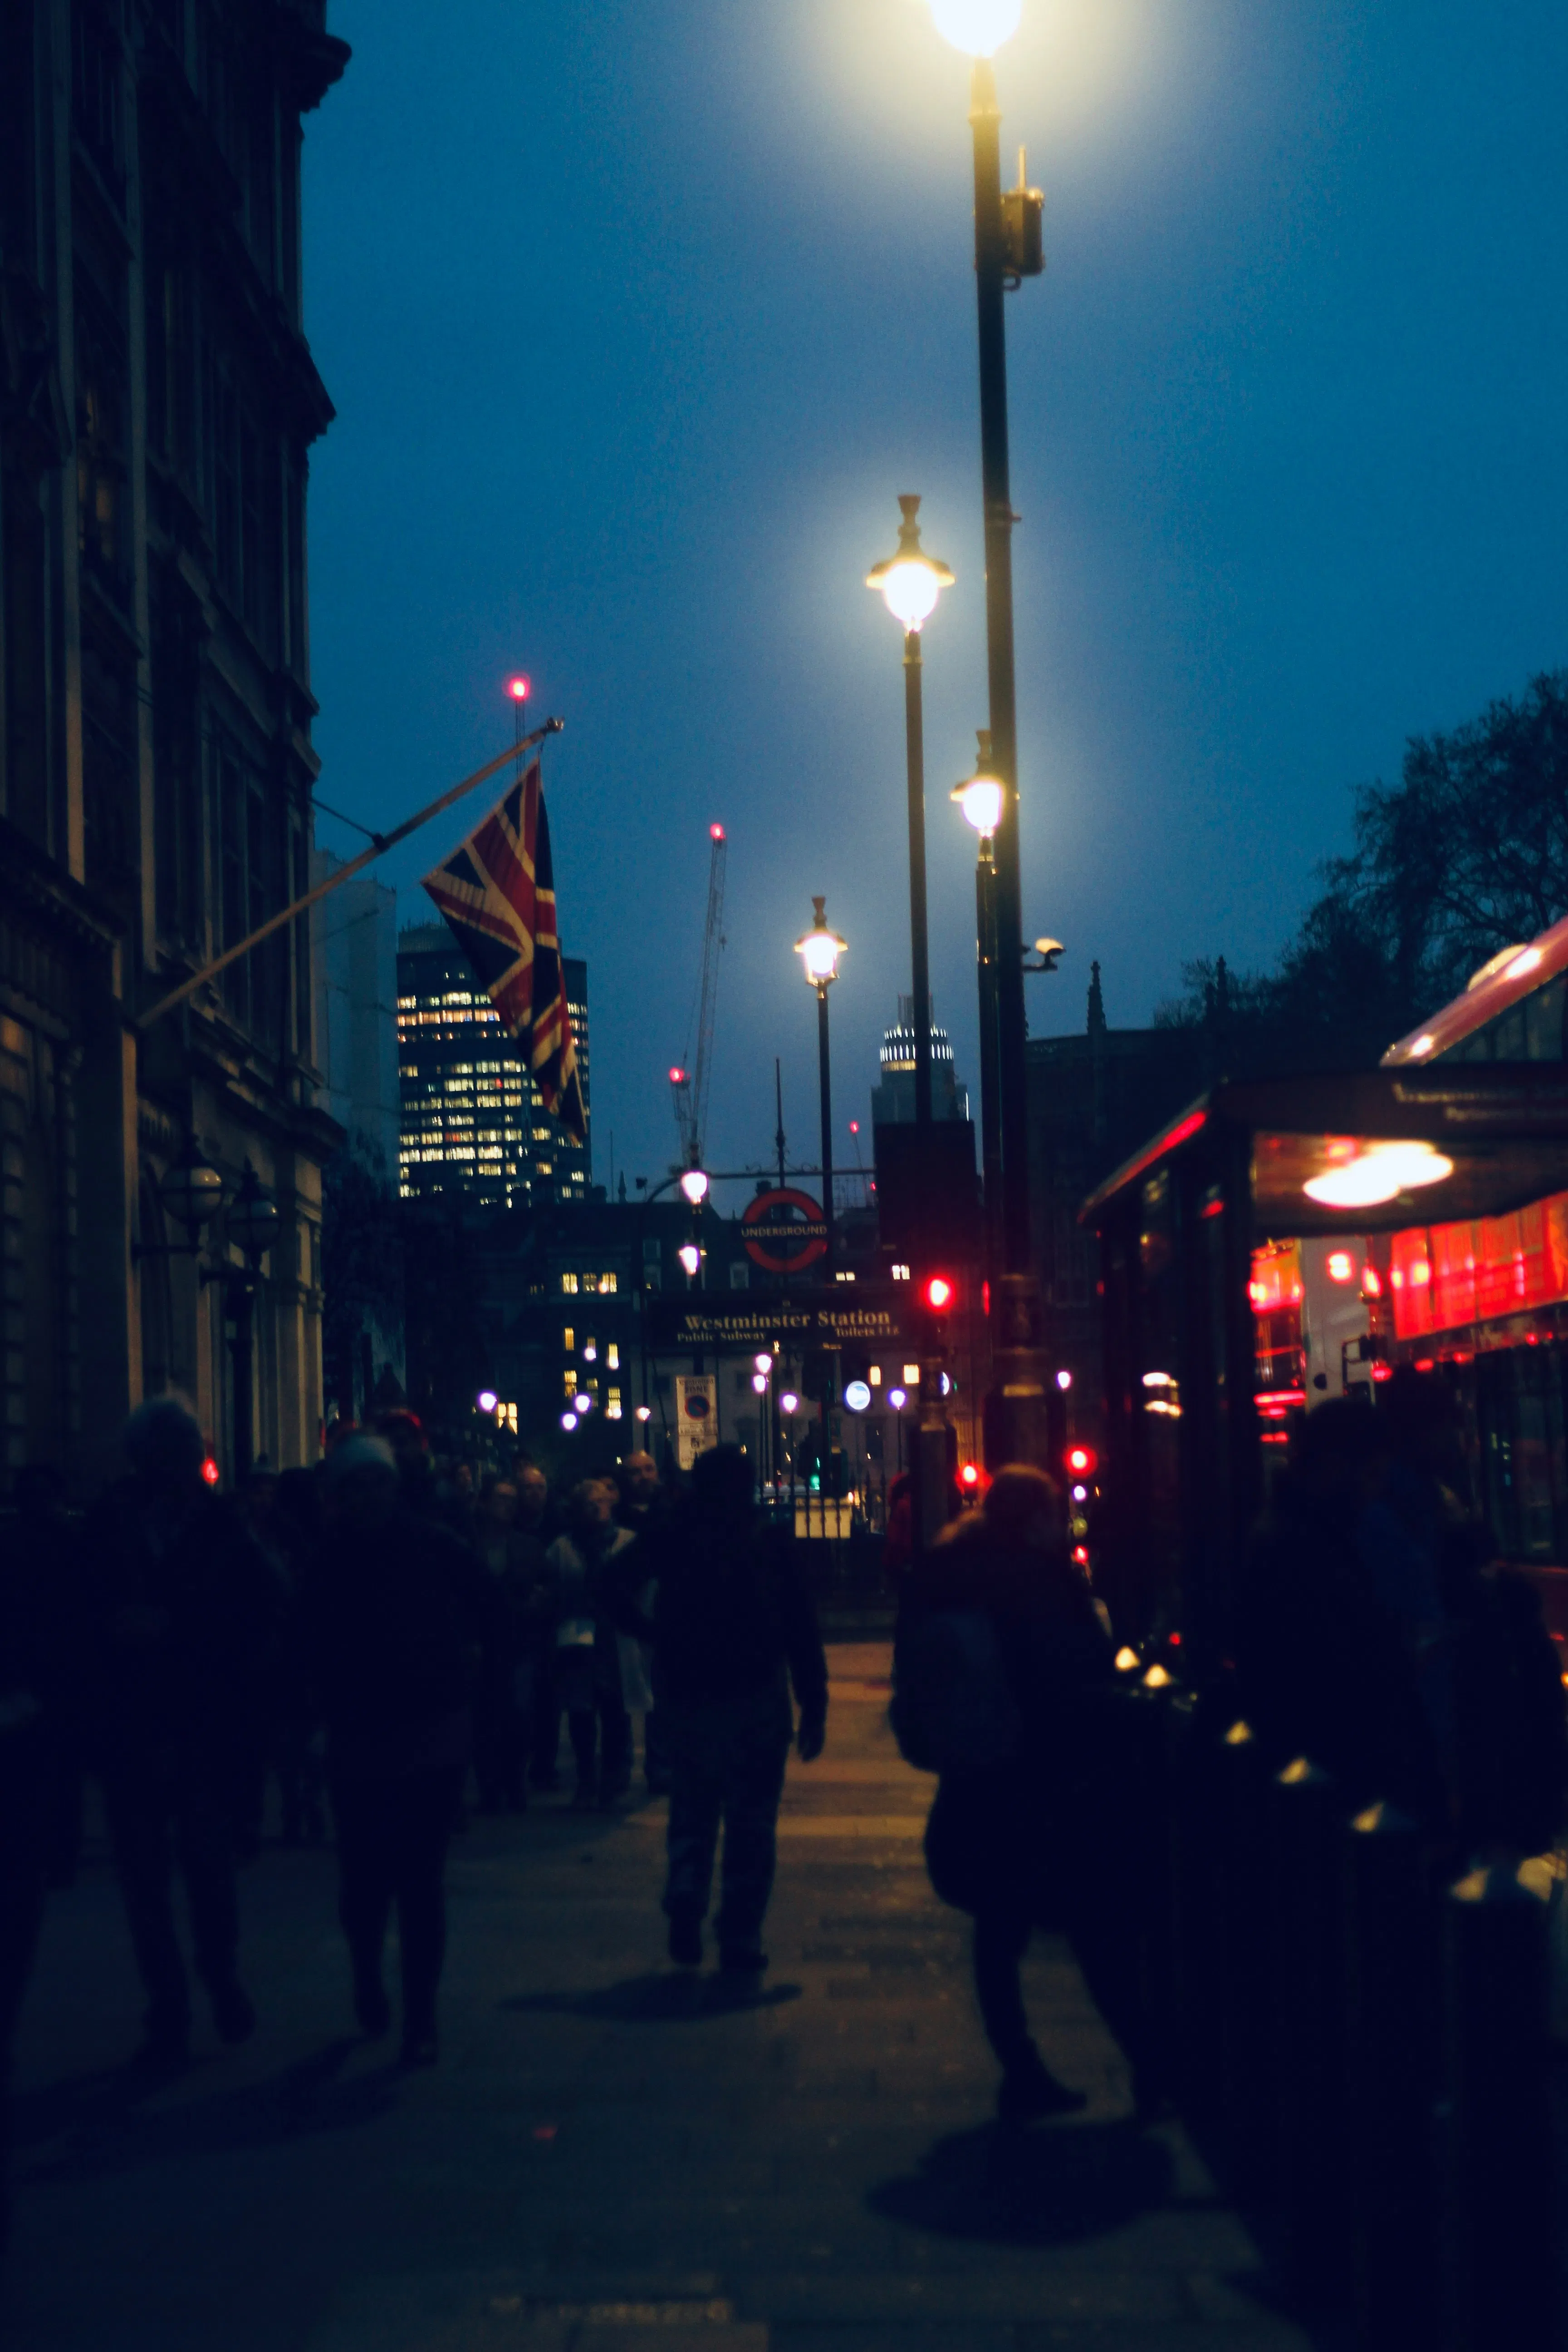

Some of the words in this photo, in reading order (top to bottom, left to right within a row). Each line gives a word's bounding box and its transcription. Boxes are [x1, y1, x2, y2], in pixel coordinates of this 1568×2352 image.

[741, 1224, 828, 1238] UNDERGROUND
[684, 1312, 811, 1330] Westminster
[818, 1308, 891, 1327] Station
[677, 1331, 714, 1342] Public
[720, 1330, 767, 1343] Subway
[835, 1326, 875, 1338] Toilets
